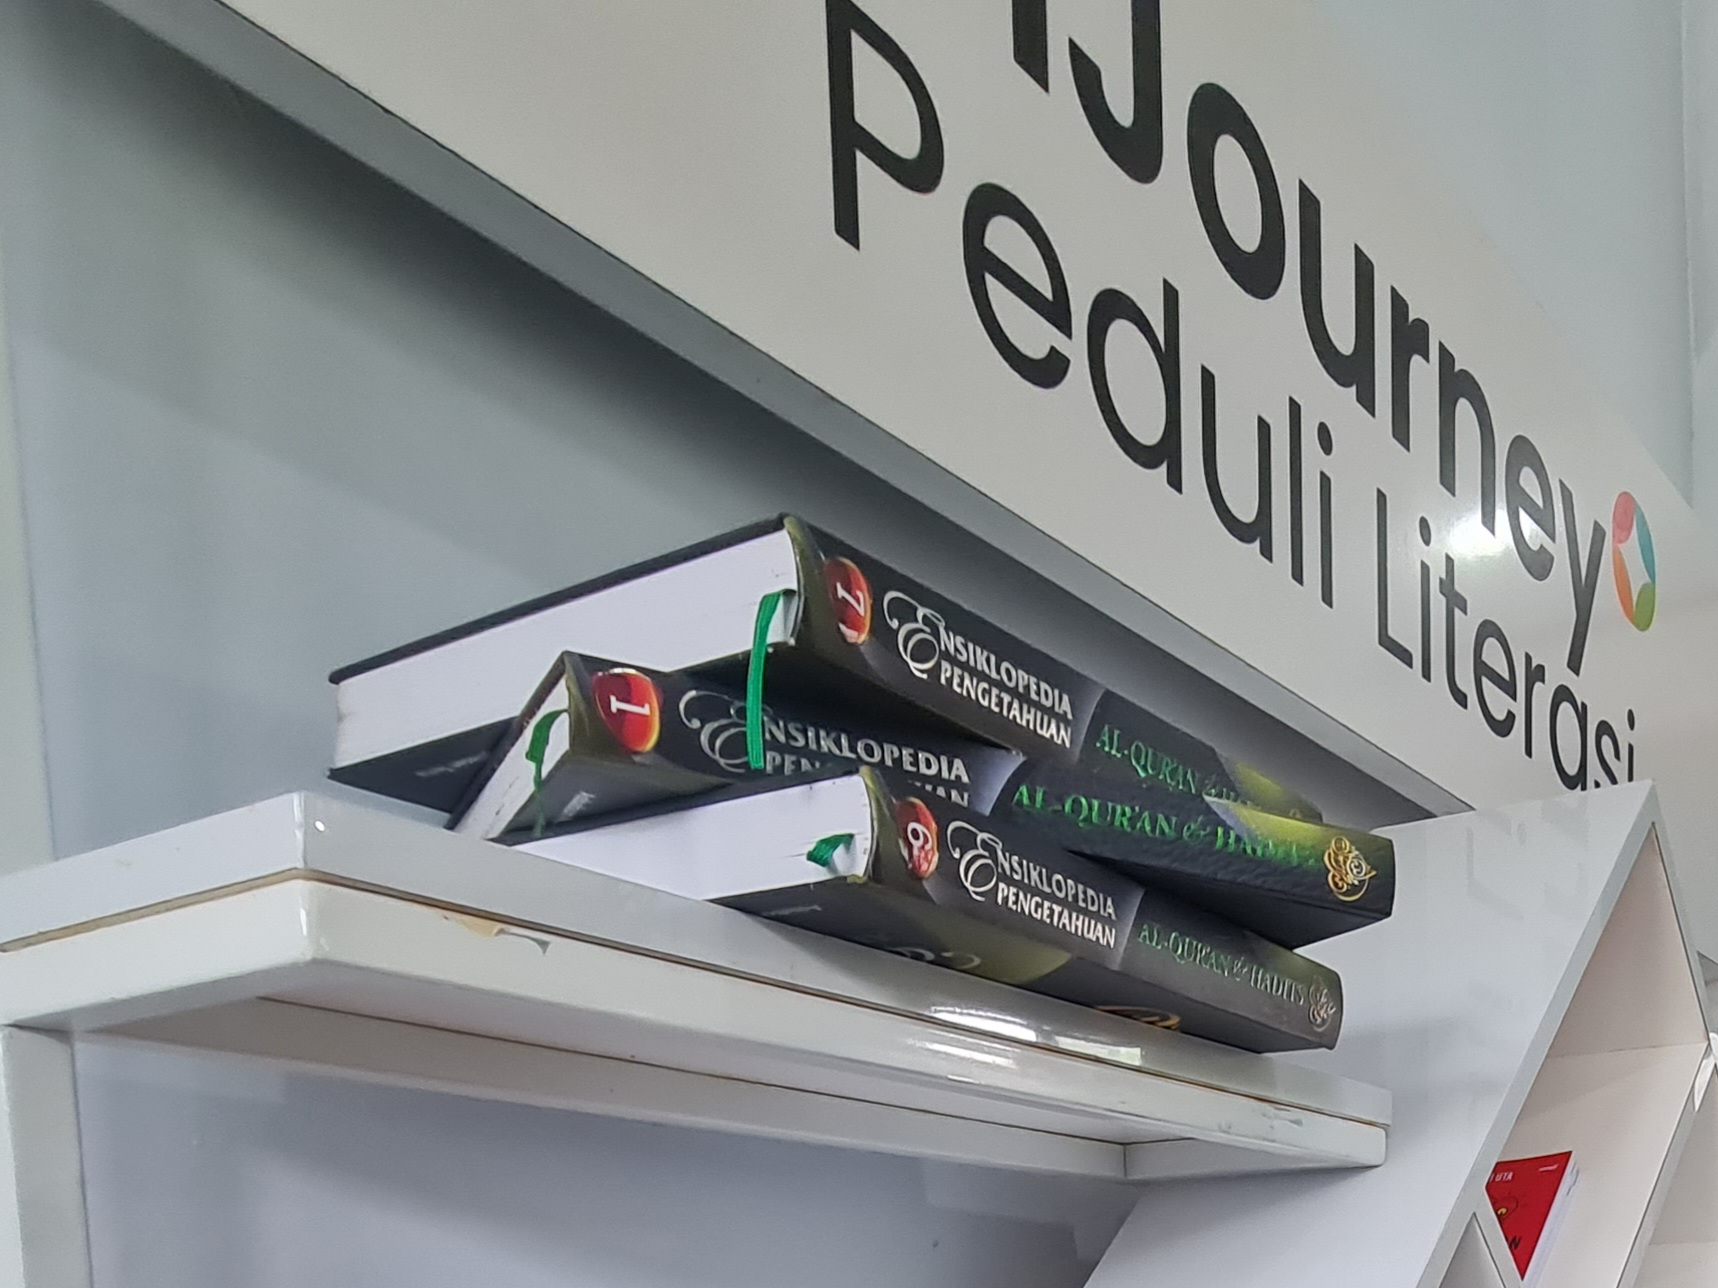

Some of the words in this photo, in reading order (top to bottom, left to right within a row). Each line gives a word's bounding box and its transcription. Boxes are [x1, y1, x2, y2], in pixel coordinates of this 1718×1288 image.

[825, 0, 1334, 609] Peduli
[1376, 487, 1635, 791] Literasi
[884, 590, 1073, 720] ENSIKLOPEDIA
[610, 694, 651, 718] 1
[939, 659, 1072, 748] PENGETAHUAN
[947, 820, 1117, 921] ENSIKLOPEDIA
[998, 883, 1116, 949] PENGETAHUAN
[1250, 965, 1305, 1005] HADITS
